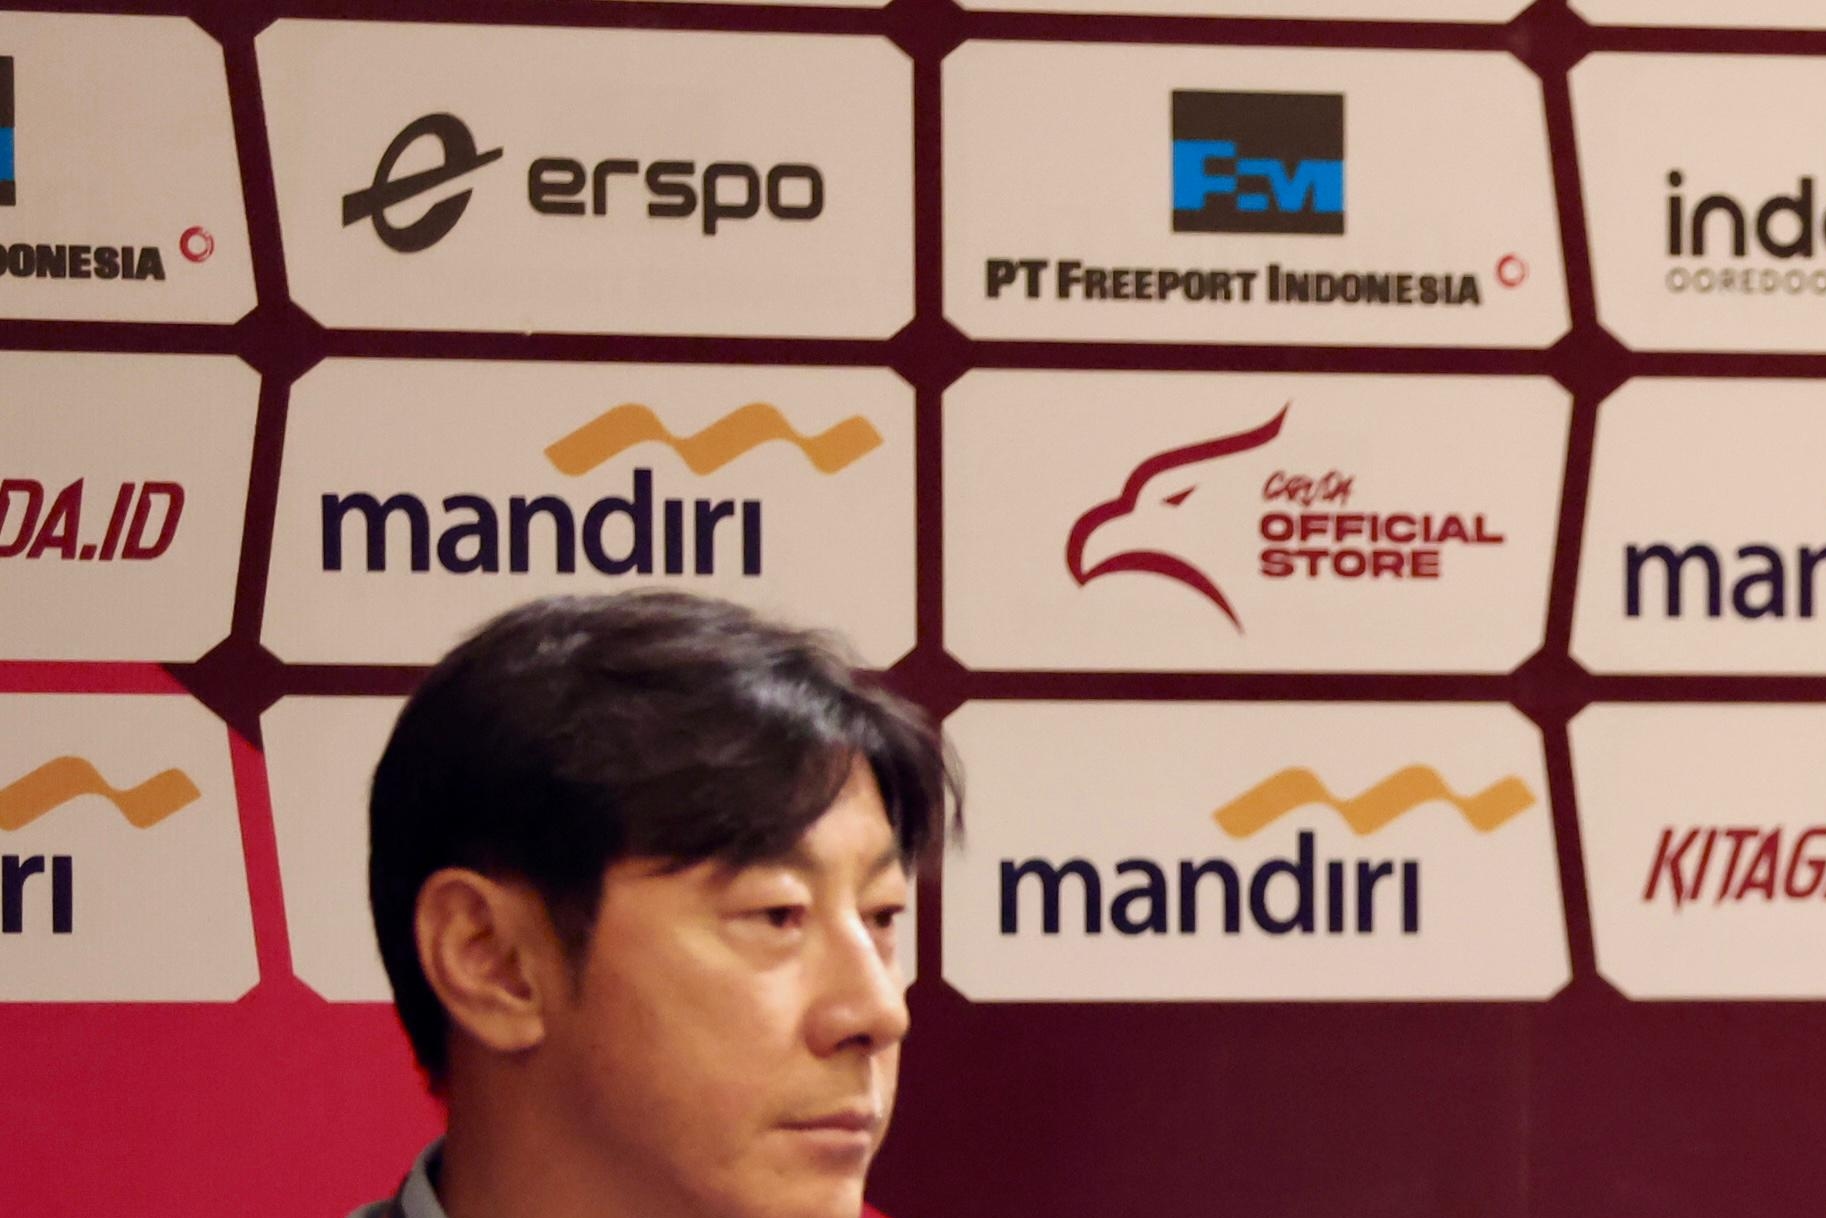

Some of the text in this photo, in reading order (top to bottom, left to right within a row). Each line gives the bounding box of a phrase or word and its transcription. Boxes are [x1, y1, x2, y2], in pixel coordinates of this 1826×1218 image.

[528, 156, 825, 237] erspo
[0, 243, 166, 281] ONESIA
[986, 259, 1481, 306] PT FREEPORT INDONESIA
[321, 468, 762, 576] mandiri
[1260, 513, 1503, 543] OFFICIAL
[1260, 550, 1440, 578] STORE
[1000, 830, 1420, 935] mandiri
